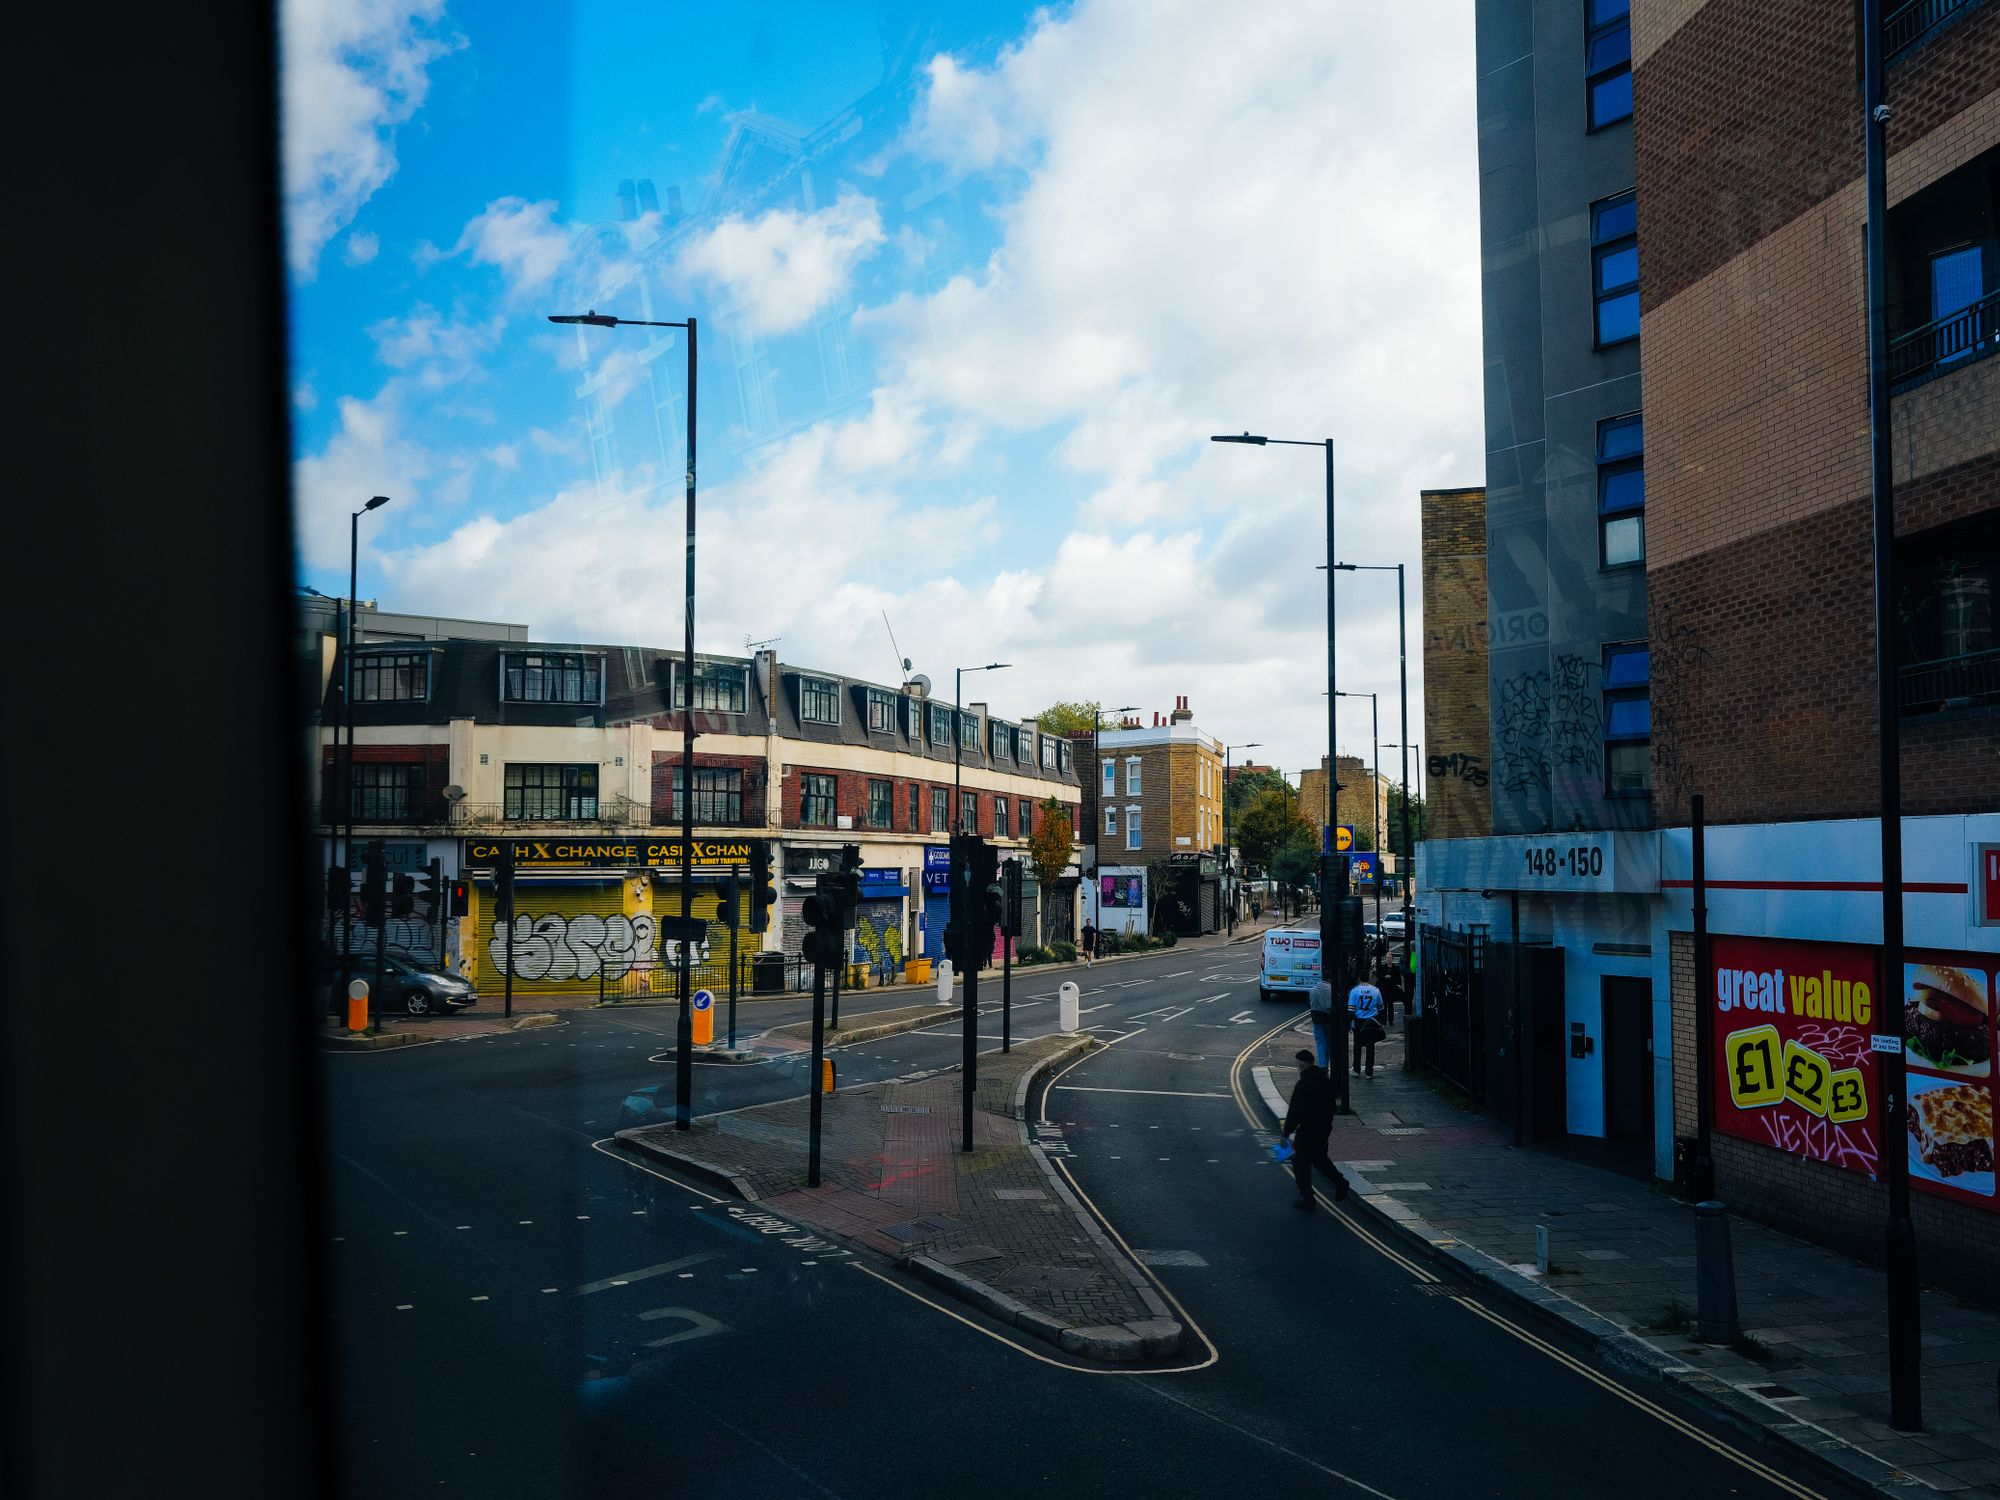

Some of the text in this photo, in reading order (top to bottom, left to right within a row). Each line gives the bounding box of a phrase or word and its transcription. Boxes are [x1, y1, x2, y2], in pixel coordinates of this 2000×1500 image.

[473, 846, 529, 858] CAH
[691, 842, 751, 857] XCHAN
[663, 858, 677, 866] SELL
[700, 857, 719, 865] MONEY
[720, 857, 747, 865] TRANSFER
[1360, 995, 1374, 1011] 17
[1717, 967, 1871, 1025] great value
[1880, 1037, 1899, 1045] loading
[1736, 1039, 1775, 1095] £1
[1786, 1054, 1823, 1106] £2
[1832, 1078, 1862, 1113] £3
